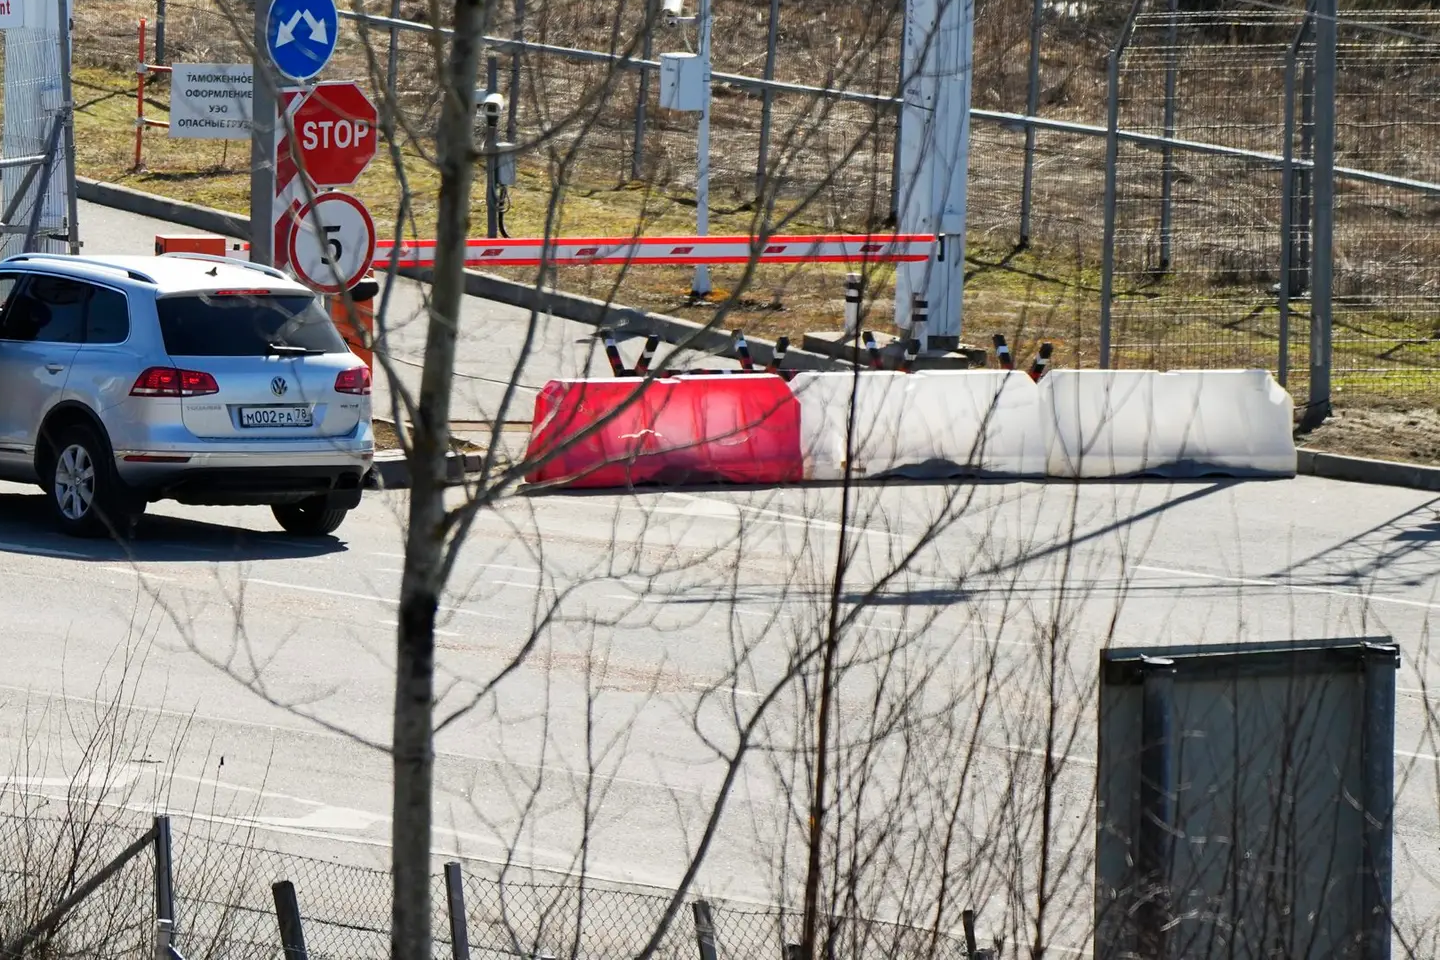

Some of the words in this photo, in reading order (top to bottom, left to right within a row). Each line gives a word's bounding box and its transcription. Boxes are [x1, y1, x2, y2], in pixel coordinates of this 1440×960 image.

[187, 74, 253, 84] ТАМОЖЕННОЕ
[185, 89, 253, 99] ОФОРМЛЕНИЕ
[209, 105, 228, 113] УЭО
[178, 118, 226, 129] ОПАСНЫЕ
[302, 119, 369, 150] STOP
[320, 225, 343, 265] 5
